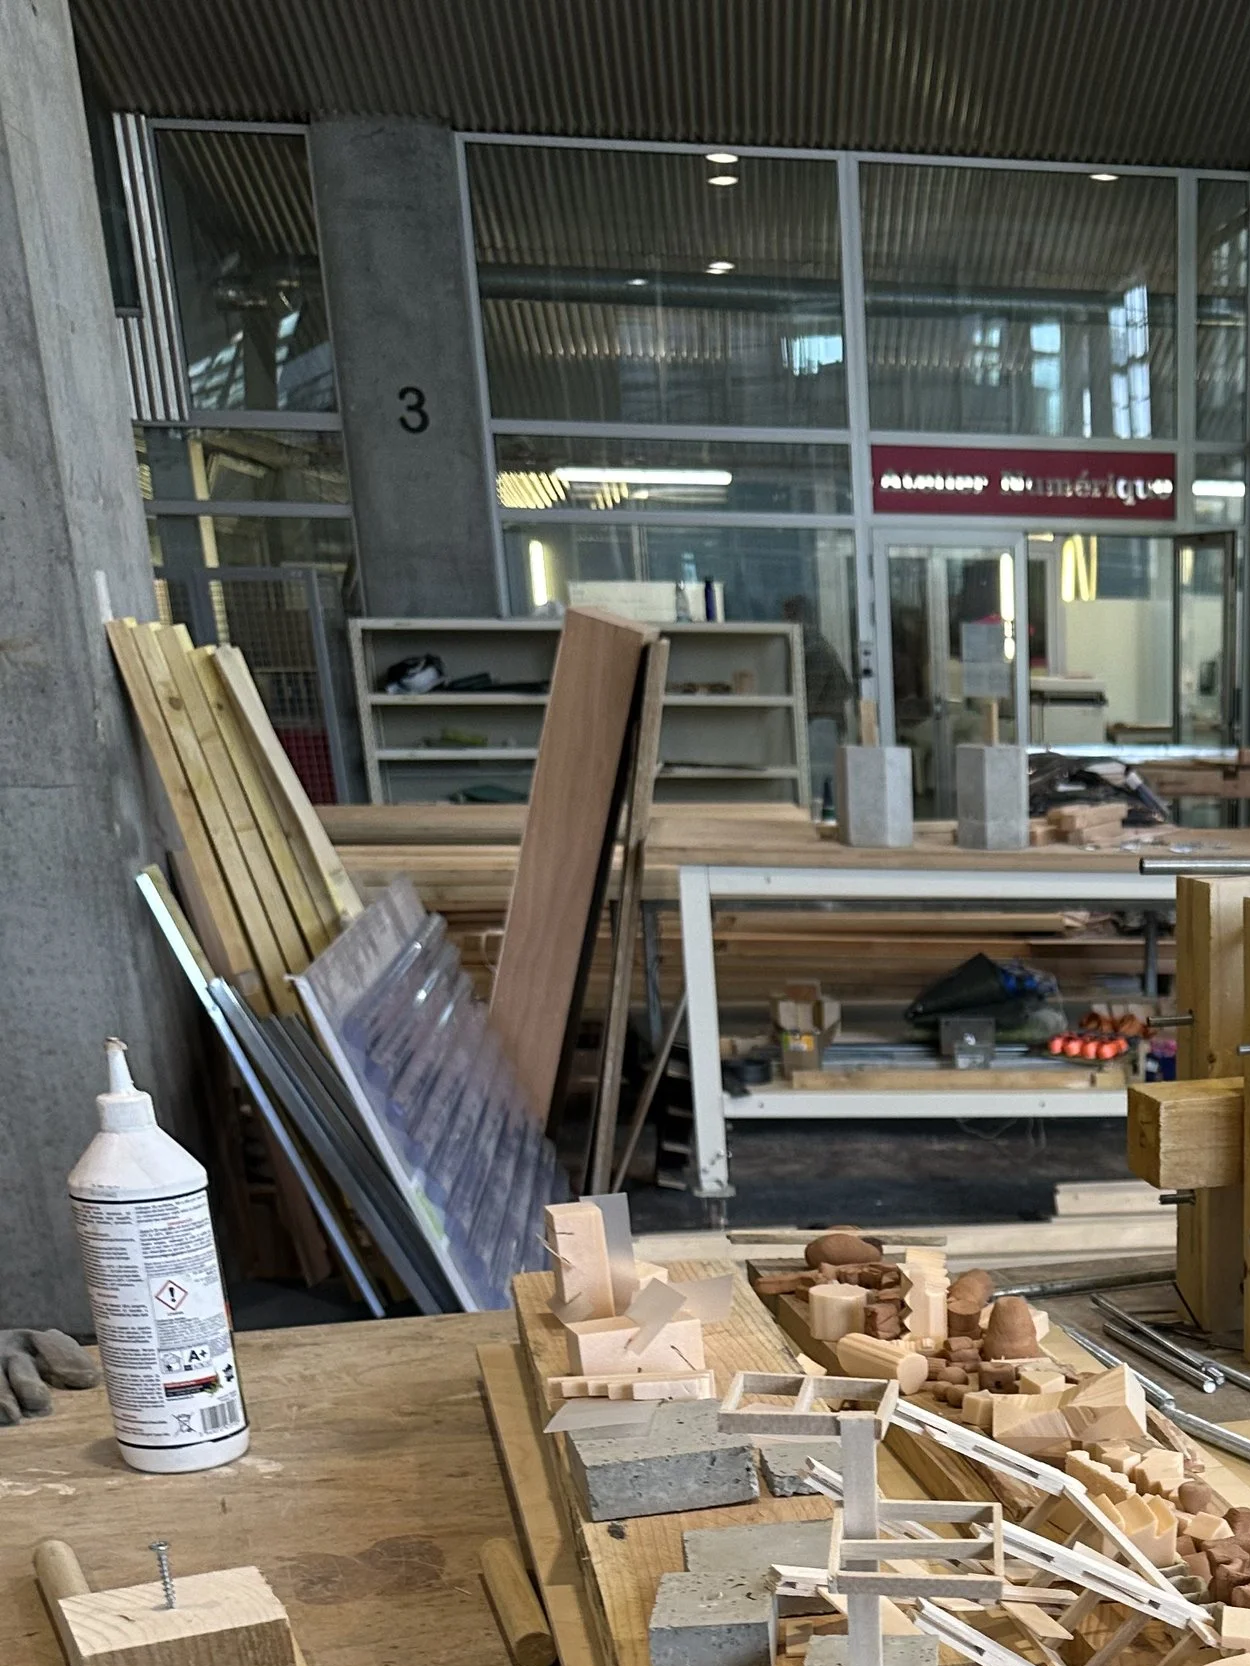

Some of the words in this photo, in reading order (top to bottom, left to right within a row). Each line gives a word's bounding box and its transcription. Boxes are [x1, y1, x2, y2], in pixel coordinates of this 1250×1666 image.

[398, 386, 429, 434] 3
[1000, 468, 1174, 506] Numérique
[189, 1349, 207, 1362] A+
